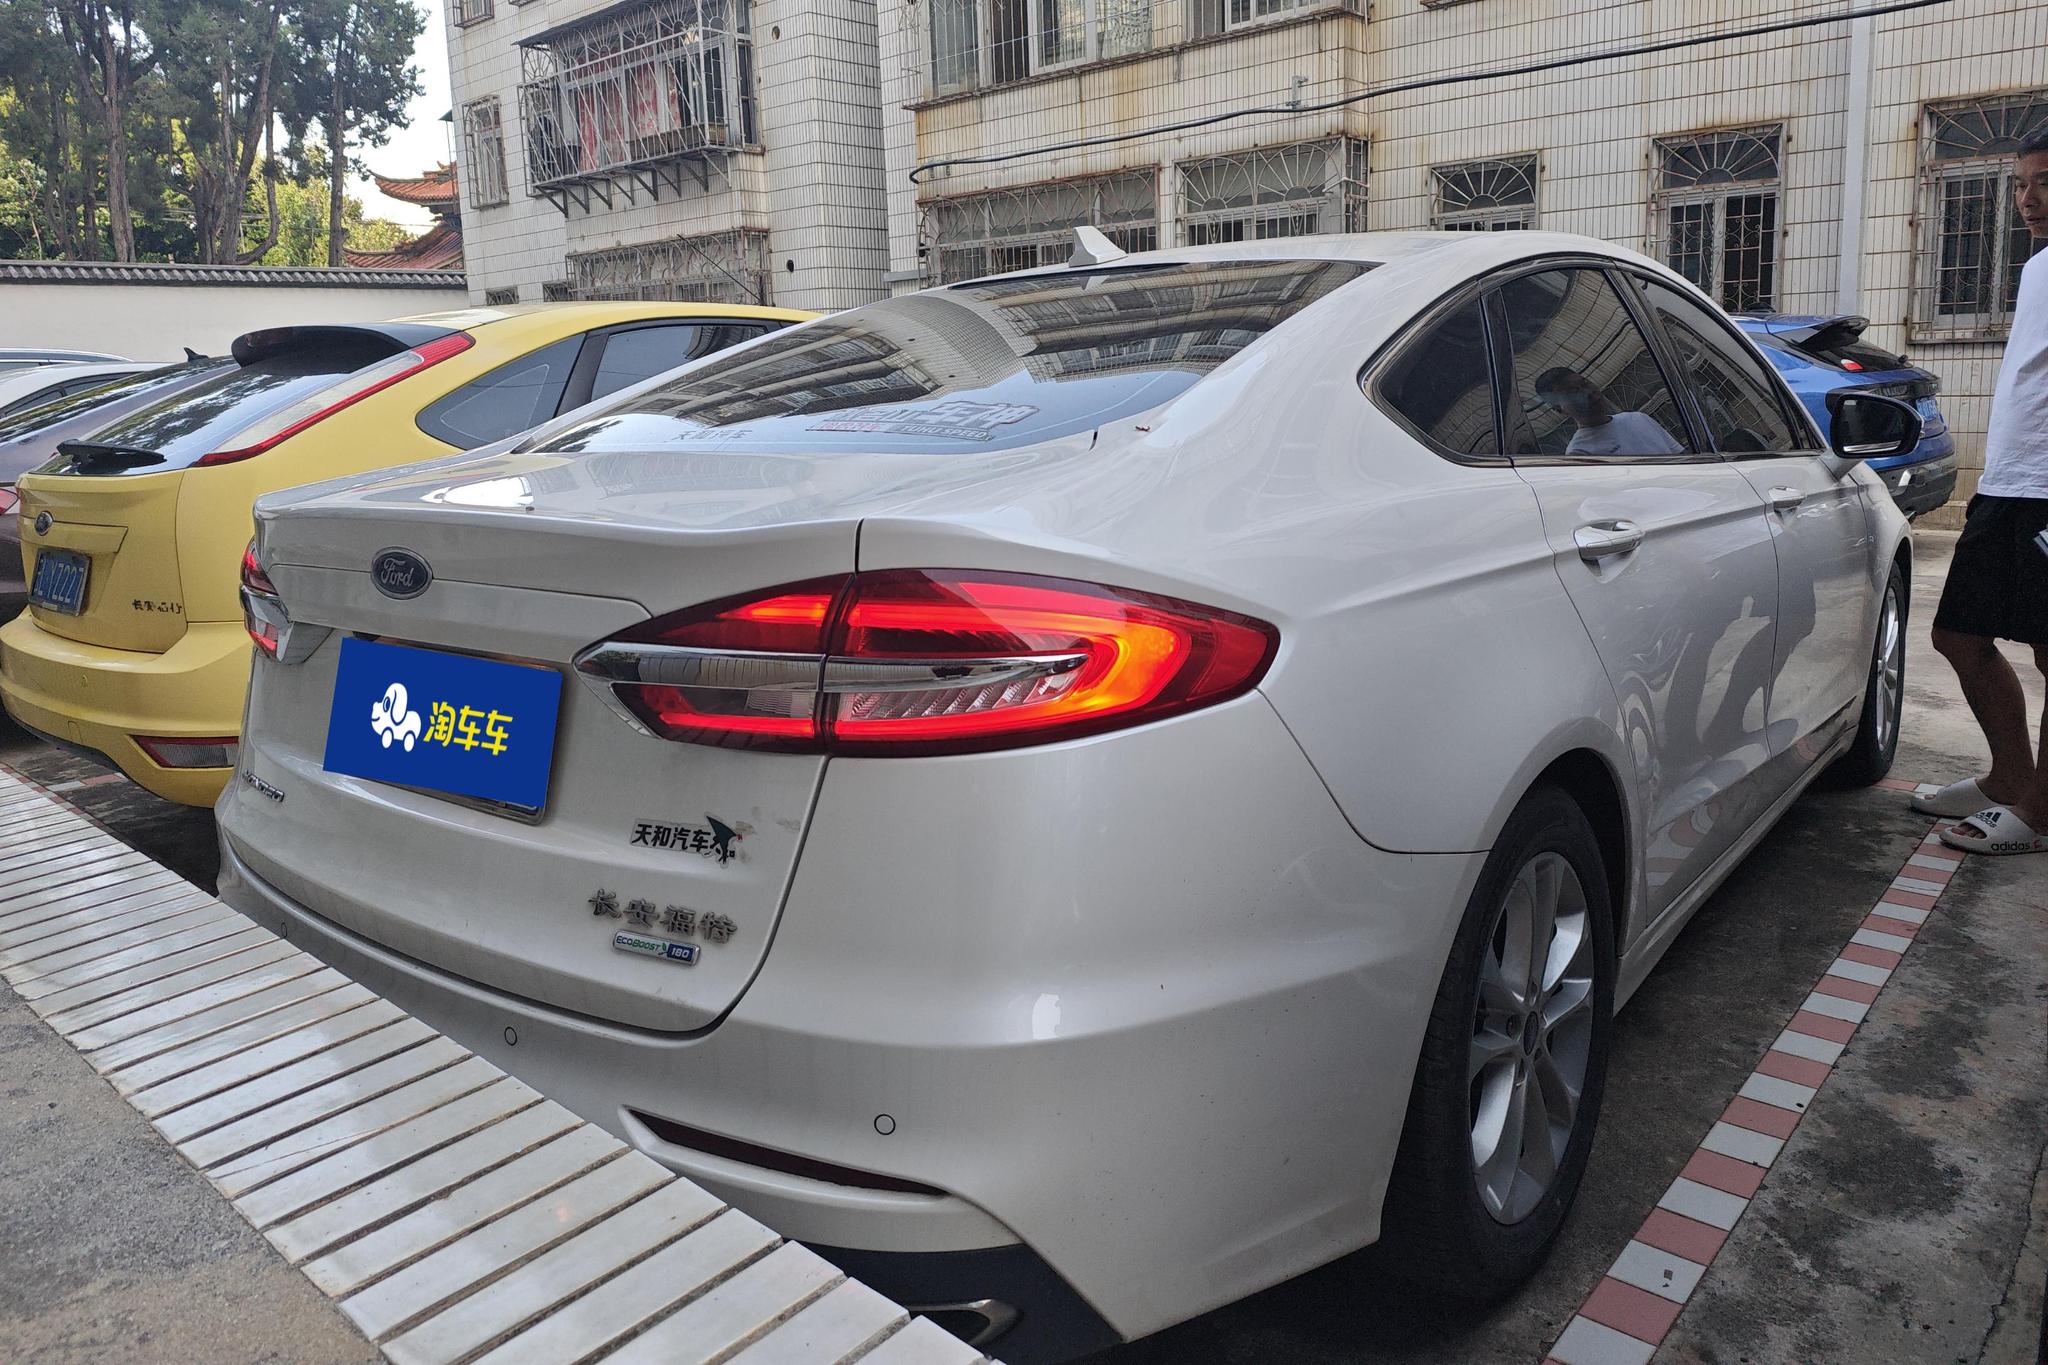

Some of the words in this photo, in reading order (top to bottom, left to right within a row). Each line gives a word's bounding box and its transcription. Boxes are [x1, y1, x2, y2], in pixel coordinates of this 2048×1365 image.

[902, 425, 940, 434] TUHU
[941, 428, 988, 438] SPEED
[380, 557, 415, 588] Ford
[631, 823, 711, 852] 天和汽车
[1990, 841, 2031, 851] adidas
[588, 888, 738, 944] 长安福特
[670, 947, 690, 960] 180
